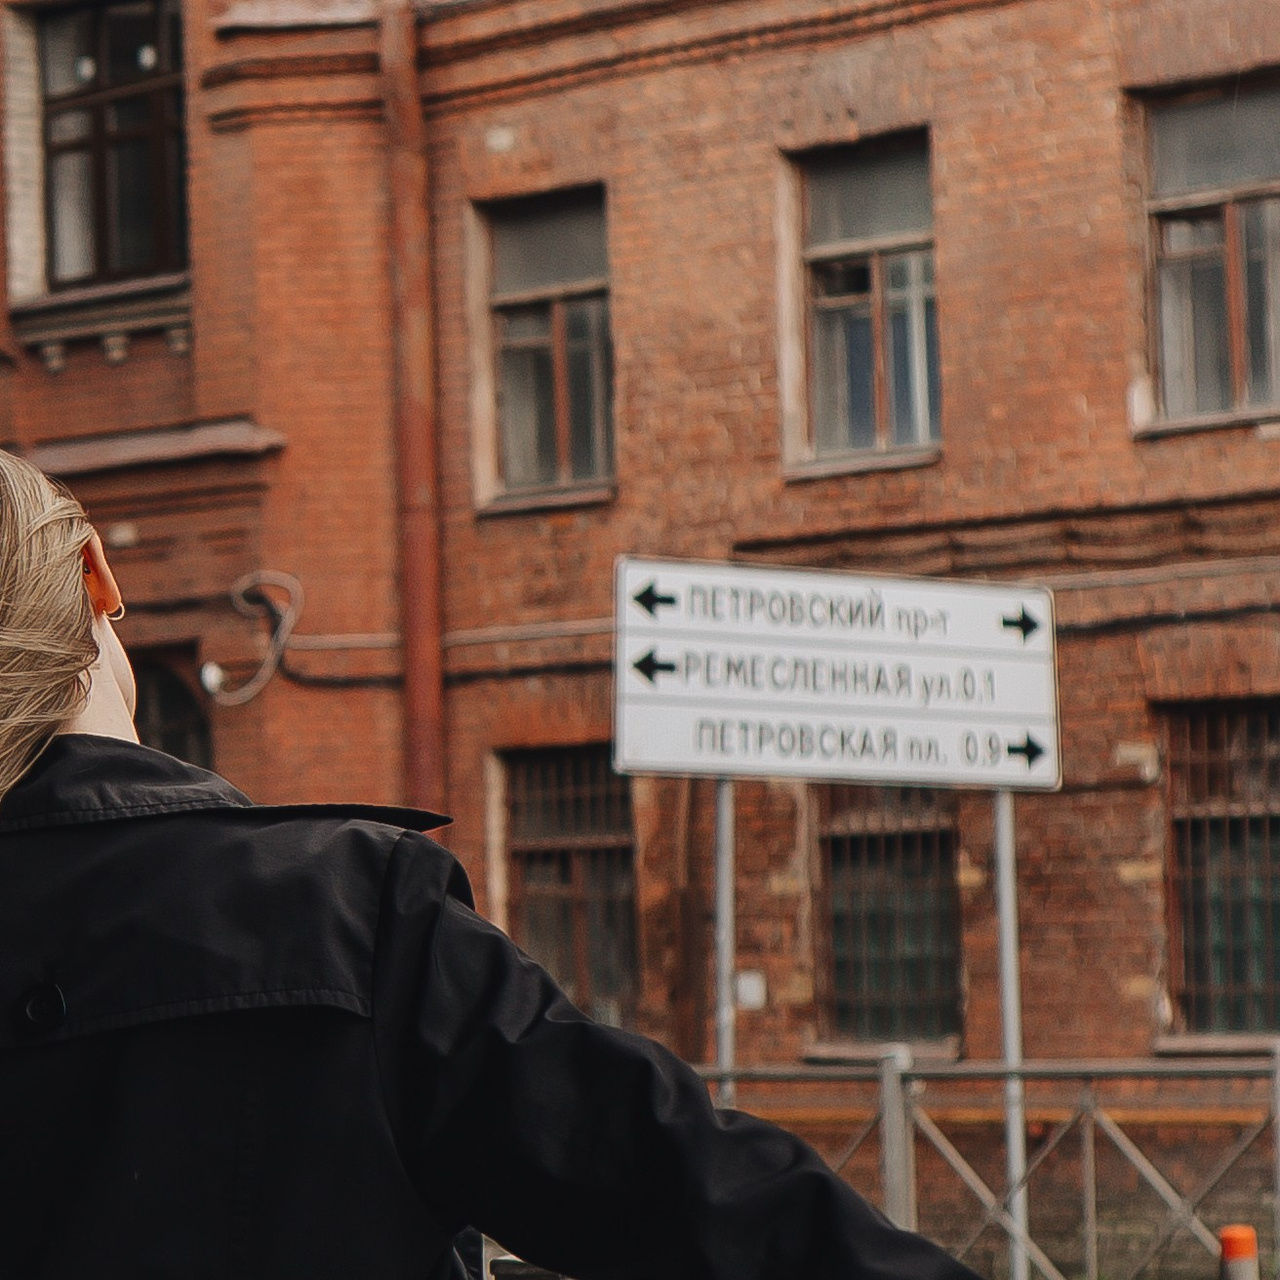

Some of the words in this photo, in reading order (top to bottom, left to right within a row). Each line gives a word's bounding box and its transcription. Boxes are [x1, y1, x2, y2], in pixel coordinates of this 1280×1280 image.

[689, 584, 885, 631] ПЕТРОВСКИЙ
[896, 607, 950, 640] пр-т
[683, 651, 912, 695] РЕМЕСЛЕННАЯ
[696, 717, 898, 761] ПЕТРОВСКАЯ
[908, 737, 948, 763] пл.
